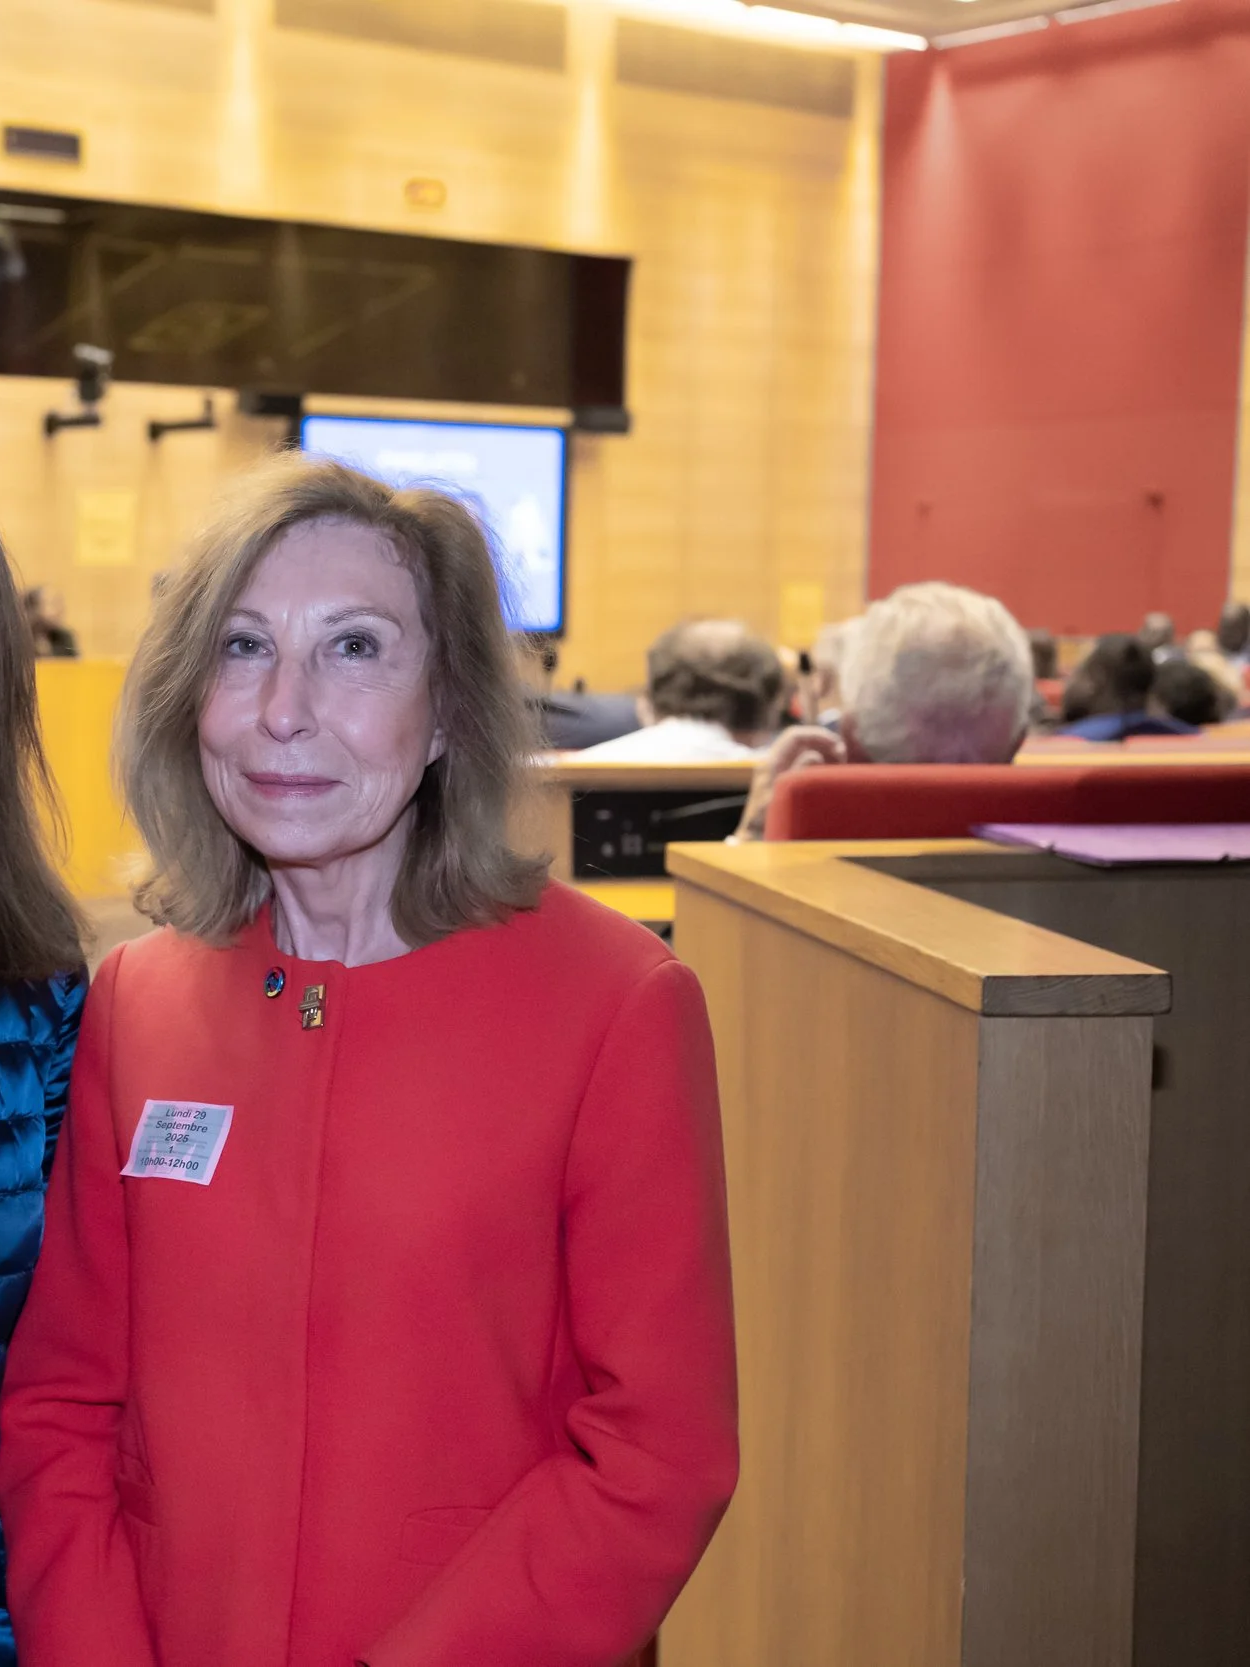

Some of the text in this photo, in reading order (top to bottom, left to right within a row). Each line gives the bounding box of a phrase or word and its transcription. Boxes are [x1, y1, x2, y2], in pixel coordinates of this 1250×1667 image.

[166, 1108, 192, 1118] Lundi
[193, 1110, 207, 1120] 29
[155, 1120, 208, 1133] Septembre
[165, 1132, 189, 1143] 2025
[140, 1157, 199, 1171] 10h00-12h00
